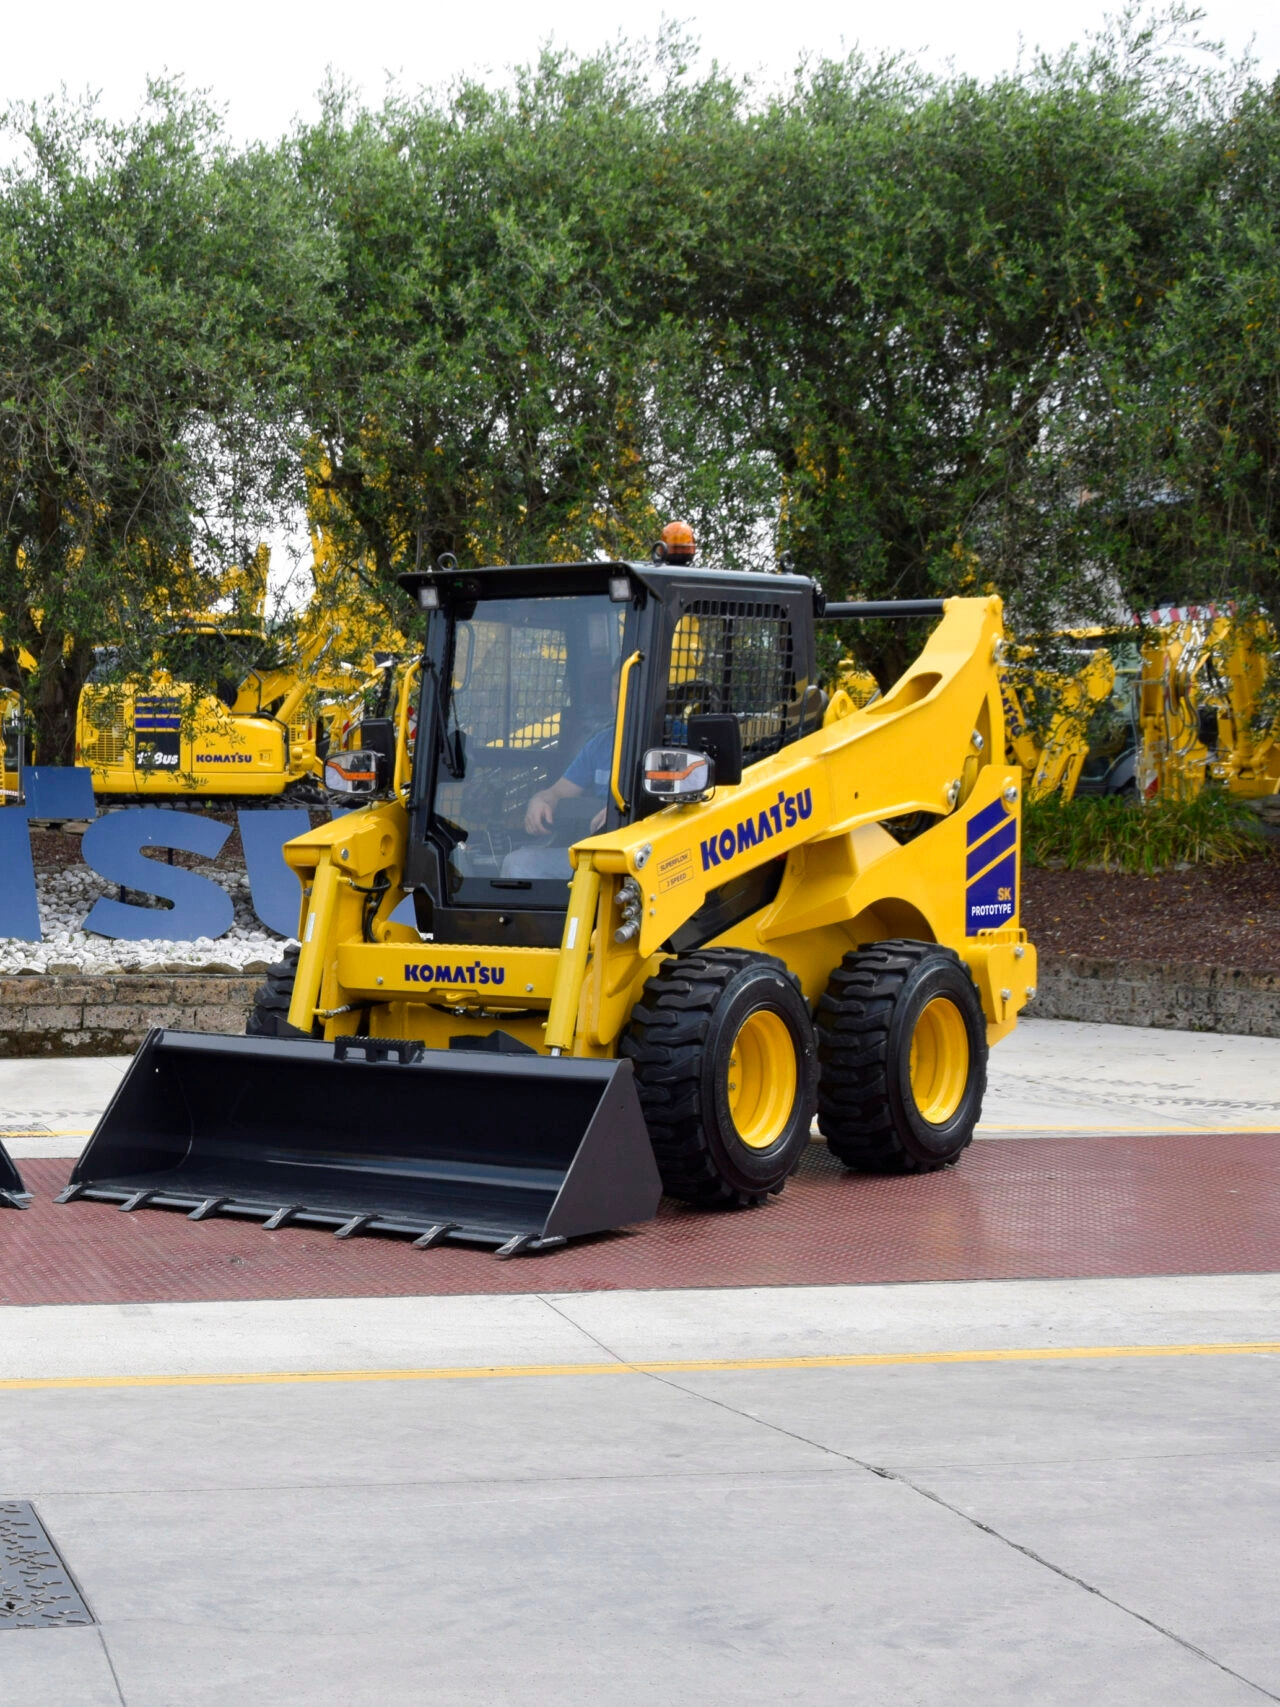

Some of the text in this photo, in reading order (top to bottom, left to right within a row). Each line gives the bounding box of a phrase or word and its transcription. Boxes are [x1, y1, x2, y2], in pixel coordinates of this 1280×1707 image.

[196, 752, 252, 763] KOMATSU
[700, 788, 812, 872] KOMATSU
[670, 872, 687, 886] SPEED
[997, 887, 1012, 901] SK
[971, 903, 1012, 917] PROTOTYPE
[404, 960, 505, 985] KOMATSU
